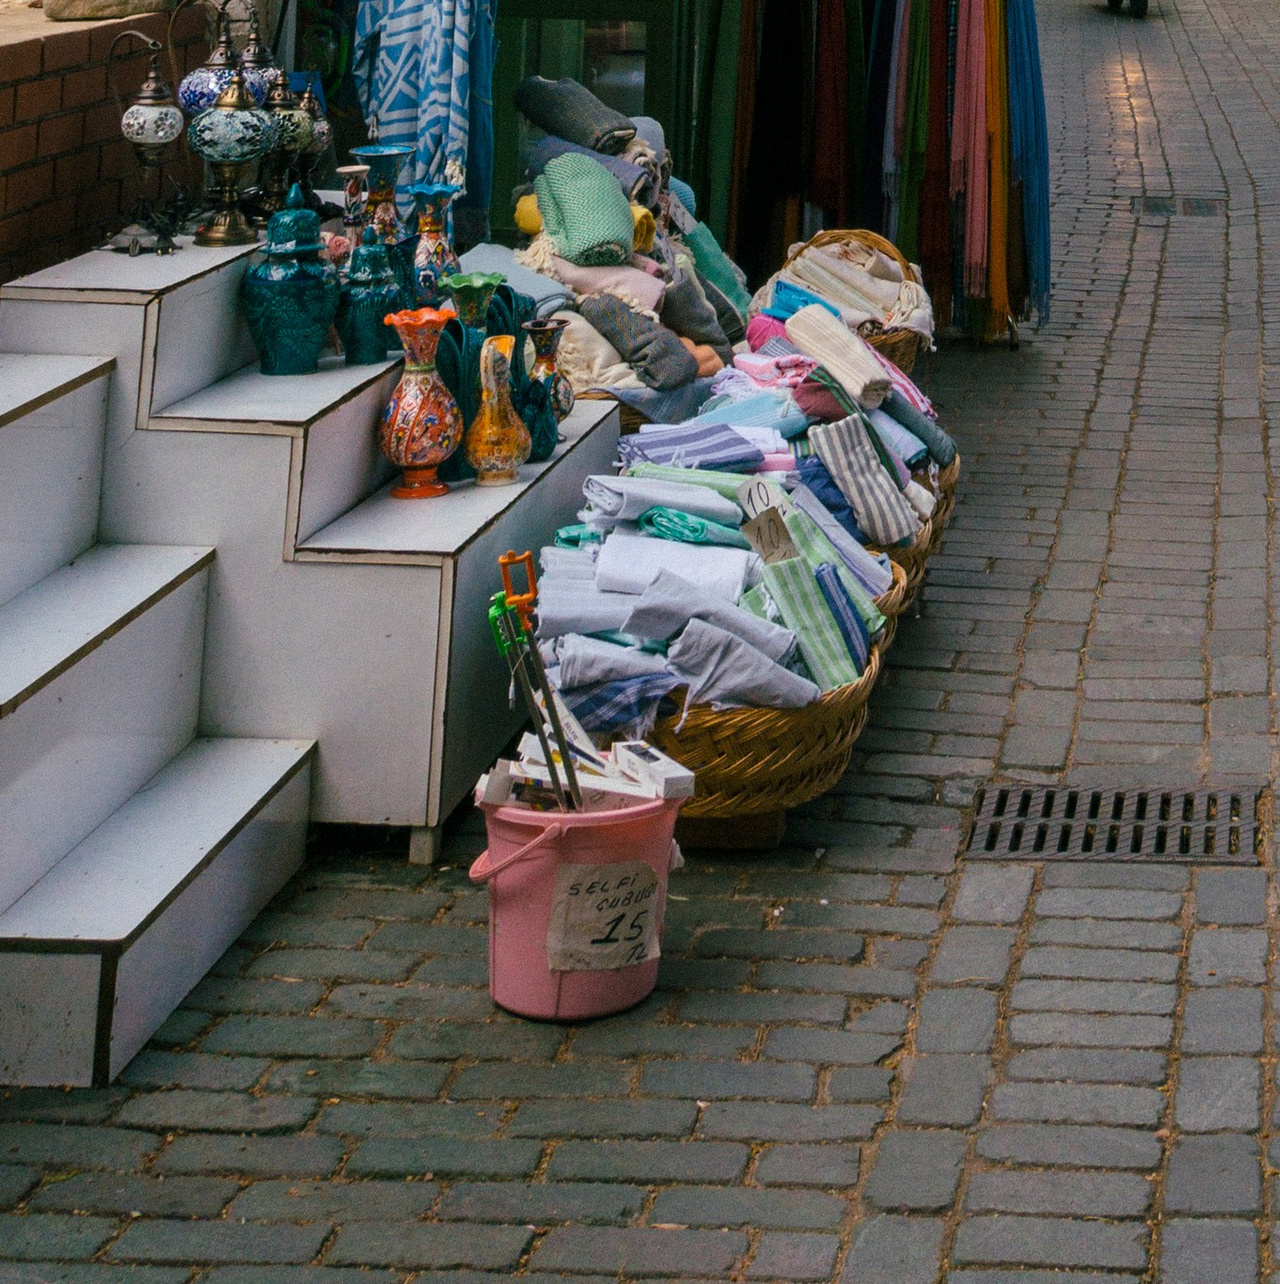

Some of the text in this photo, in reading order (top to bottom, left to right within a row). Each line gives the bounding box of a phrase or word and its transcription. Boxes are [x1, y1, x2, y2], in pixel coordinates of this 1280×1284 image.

[747, 481, 770, 516] 10
[756, 518, 781, 551] 10
[590, 909, 649, 945] 15
[626, 942, 649, 964] TL
